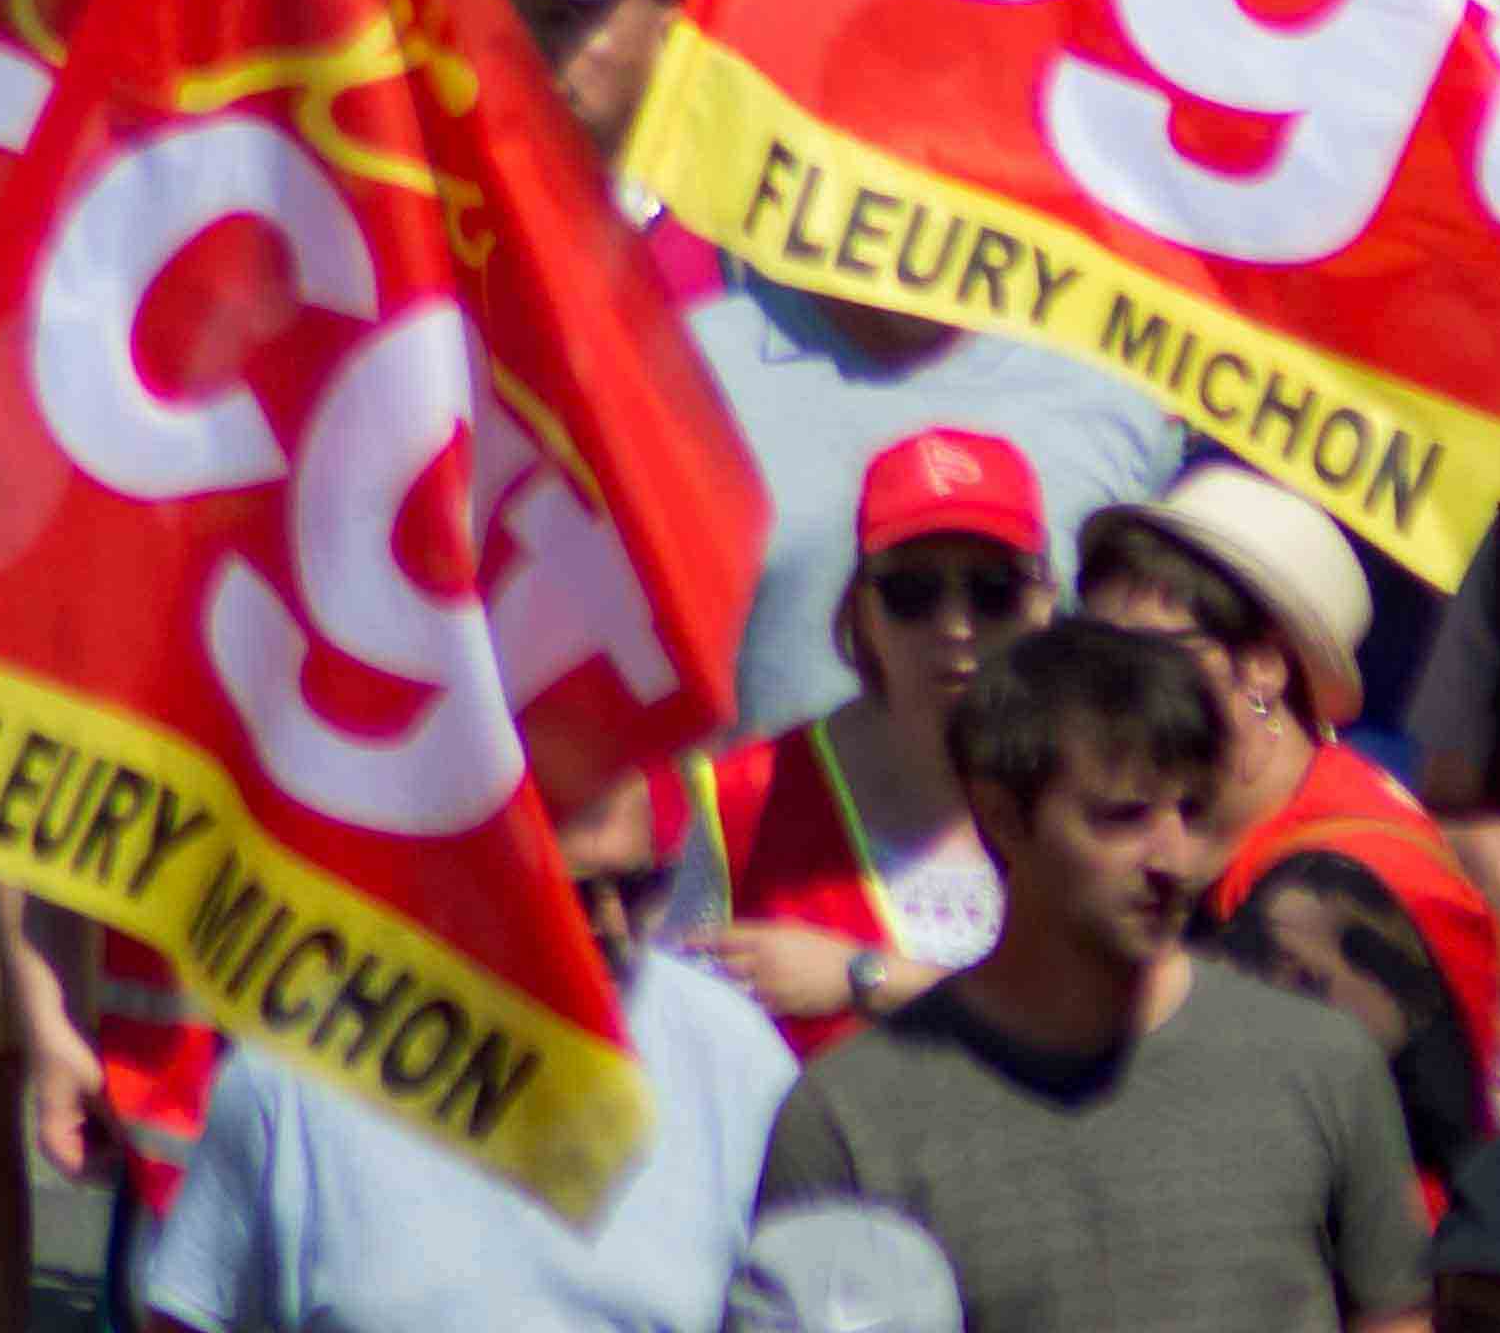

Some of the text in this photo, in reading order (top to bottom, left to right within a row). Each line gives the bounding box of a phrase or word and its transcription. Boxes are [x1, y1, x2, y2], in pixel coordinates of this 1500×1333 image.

[744, 139, 1448, 534] FLEURY MICHON
[186, 850, 552, 1141] MICHON
